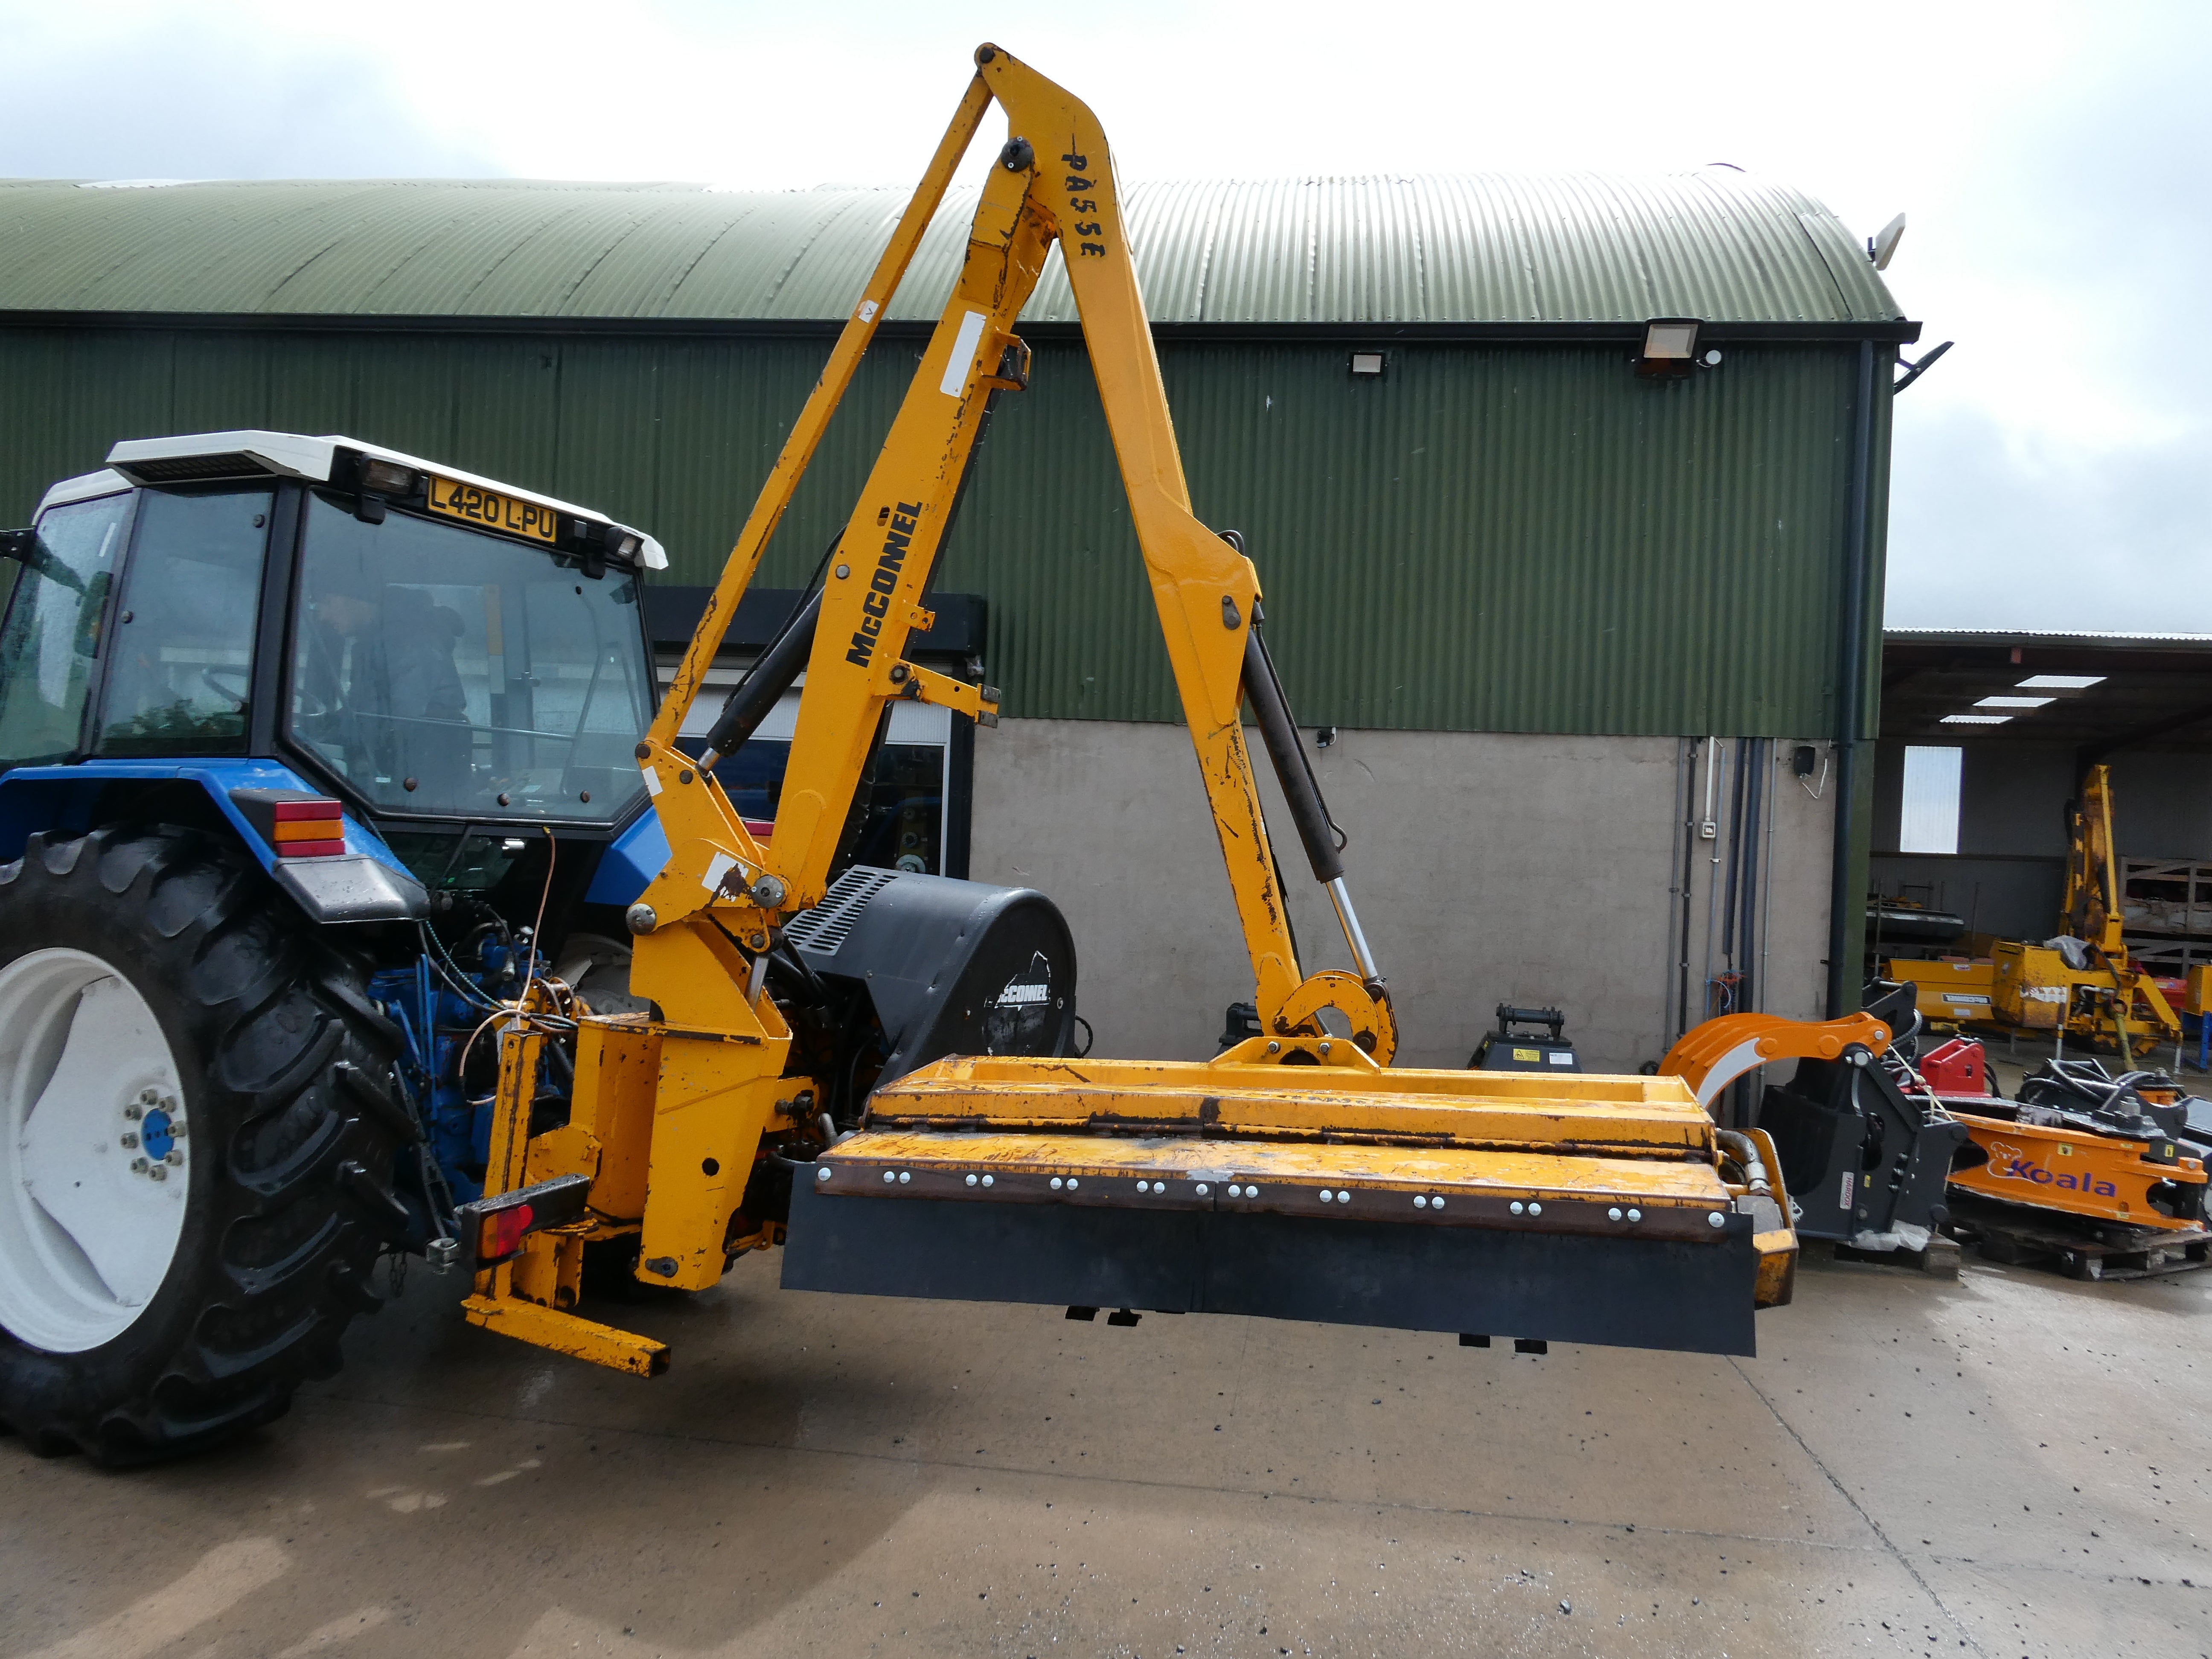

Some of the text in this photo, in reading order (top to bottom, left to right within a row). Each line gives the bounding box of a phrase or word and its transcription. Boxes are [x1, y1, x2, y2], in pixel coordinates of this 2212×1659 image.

[431, 478, 554, 538] L420 LPU
[845, 501, 923, 668] McCONNEL
[2006, 1160, 2116, 1197] Koala
